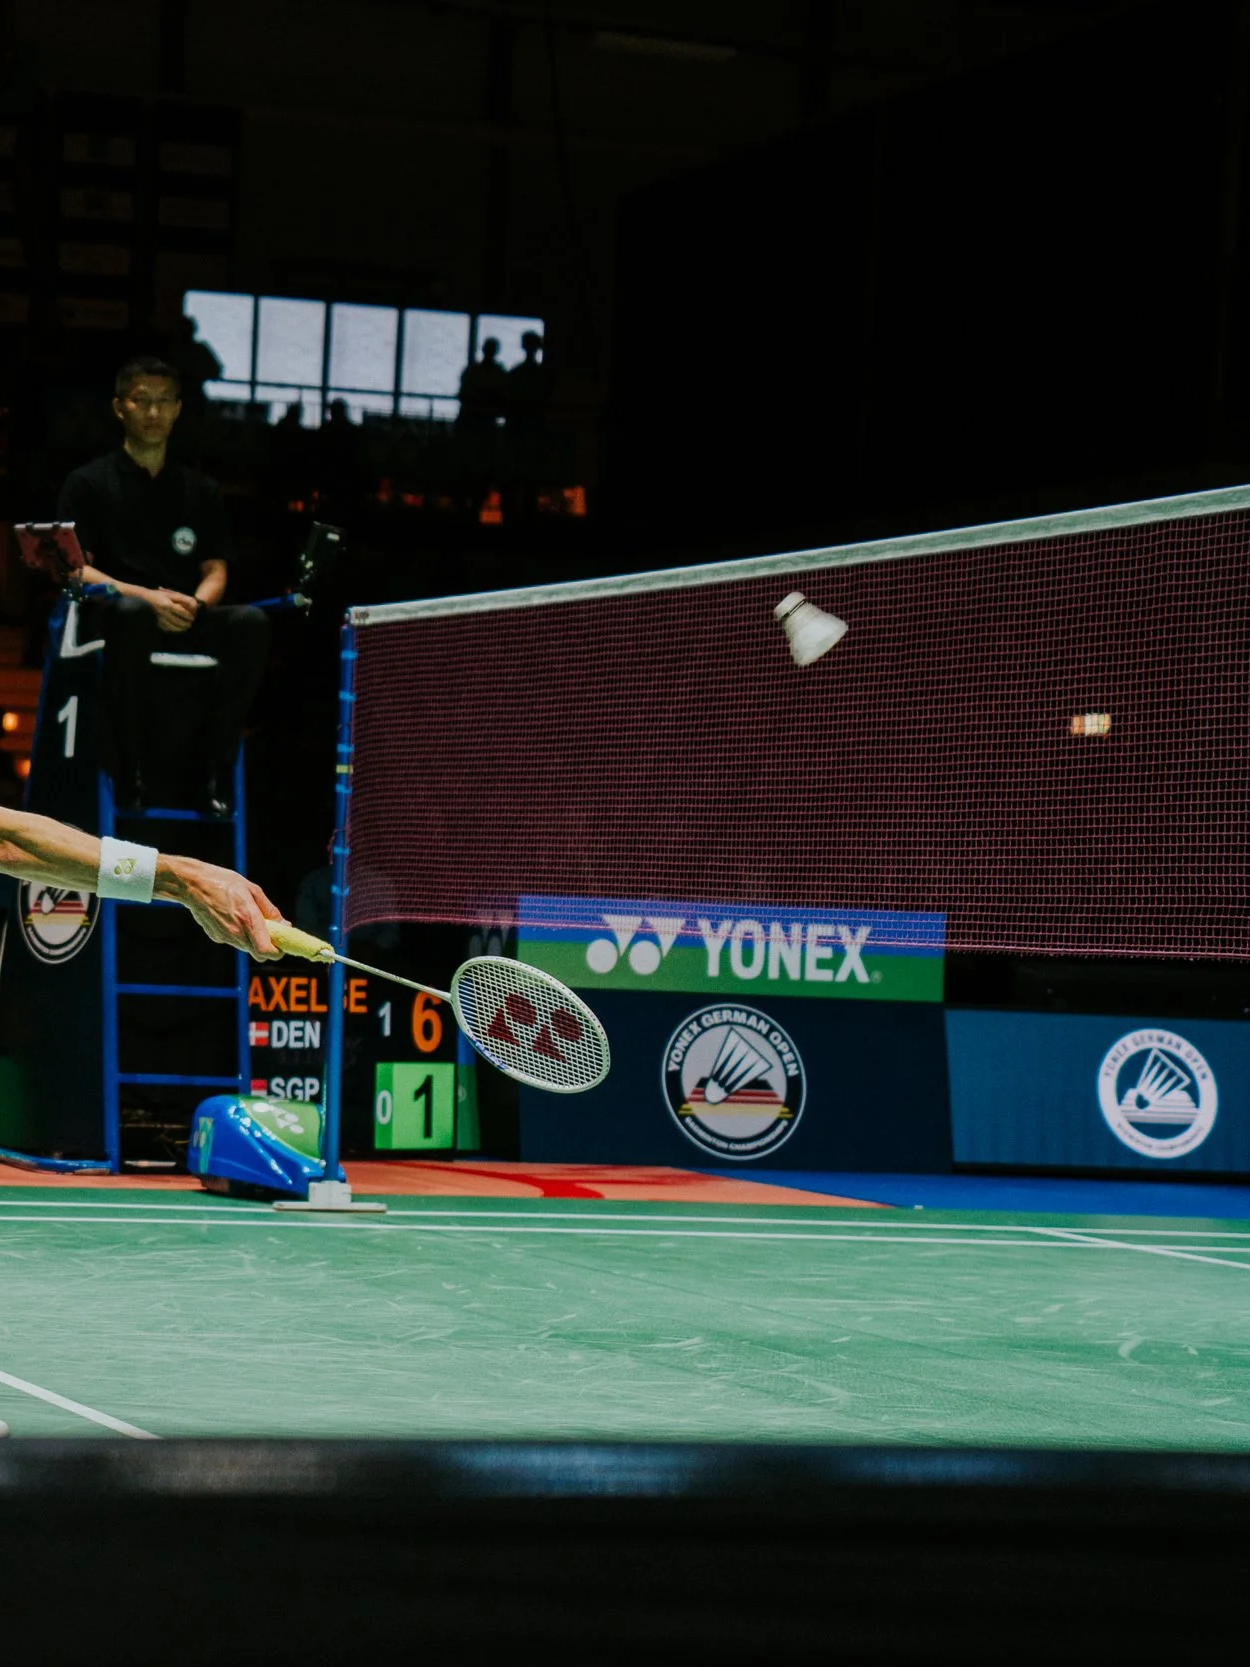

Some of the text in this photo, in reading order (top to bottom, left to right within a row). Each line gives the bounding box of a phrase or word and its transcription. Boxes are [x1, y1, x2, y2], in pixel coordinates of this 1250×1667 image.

[57, 695, 79, 759] 1
[697, 917, 871, 983] YONEX
[248, 976, 368, 1013] AXELE
[377, 986, 443, 1053] 1 6
[270, 1020, 321, 1049] DEN
[668, 1009, 800, 1078] YONEX GERMAN OPEN
[270, 1077, 321, 1103] SGP
[375, 1074, 434, 1139] 0 1
